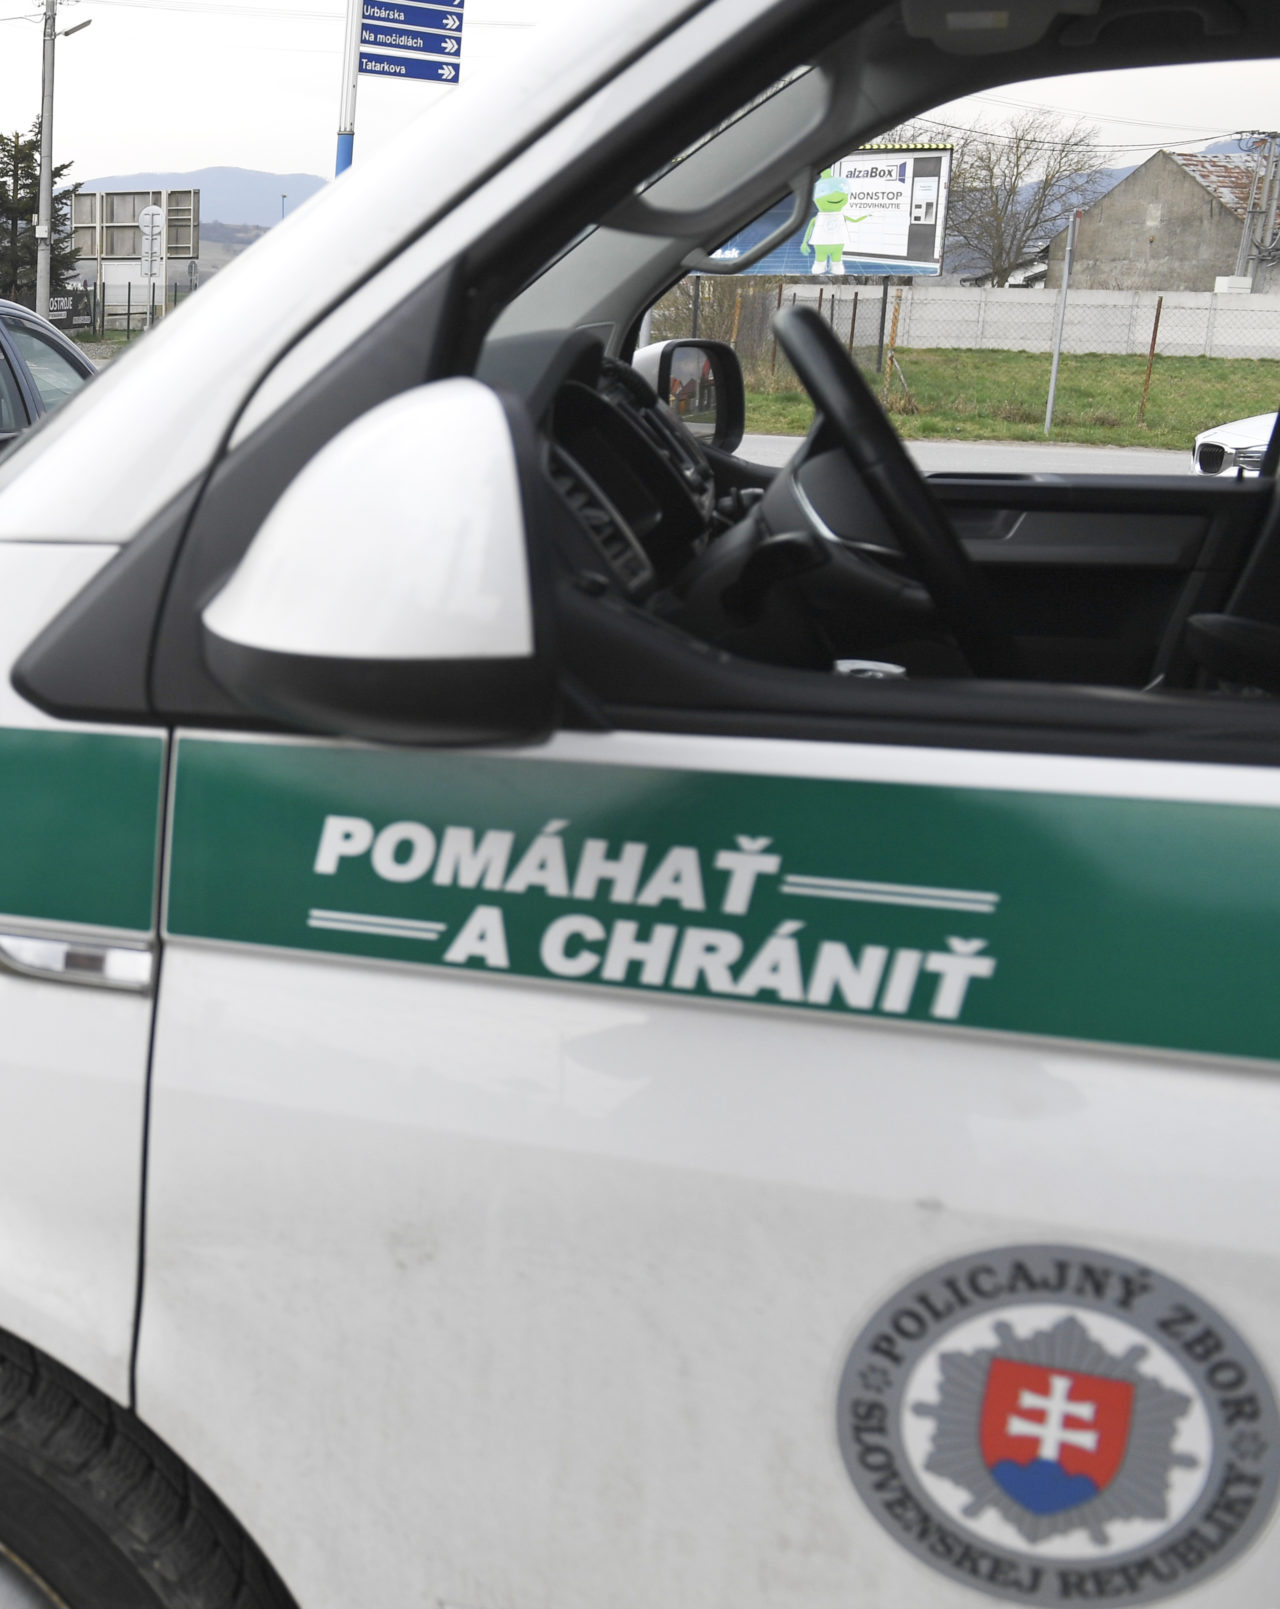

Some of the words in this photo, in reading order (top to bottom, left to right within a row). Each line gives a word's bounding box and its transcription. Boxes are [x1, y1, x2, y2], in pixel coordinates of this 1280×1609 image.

[363, 4, 405, 21] Urbárska
[361, 30, 375, 42] Na
[376, 33, 424, 48] močidlách
[361, 59, 406, 74] Tatarkova
[845, 166, 894, 179] alzaBox
[849, 191, 903, 201] NONSTOP
[849, 202, 901, 210] VYZDVIHNUTIE
[49, 296, 73, 310] OSTROJE
[313, 814, 782, 916] POMÁHAŤ
[442, 904, 510, 968] A
[538, 913, 997, 1020] CHRÁNIŤ
[870, 1258, 1153, 1367] POLICAJNÝ
[1155, 1302, 1262, 1427] ZBOR
[851, 1397, 1045, 1596] SLOVENSKEJ
[1056, 1460, 1263, 1600] REPUBLIKY
